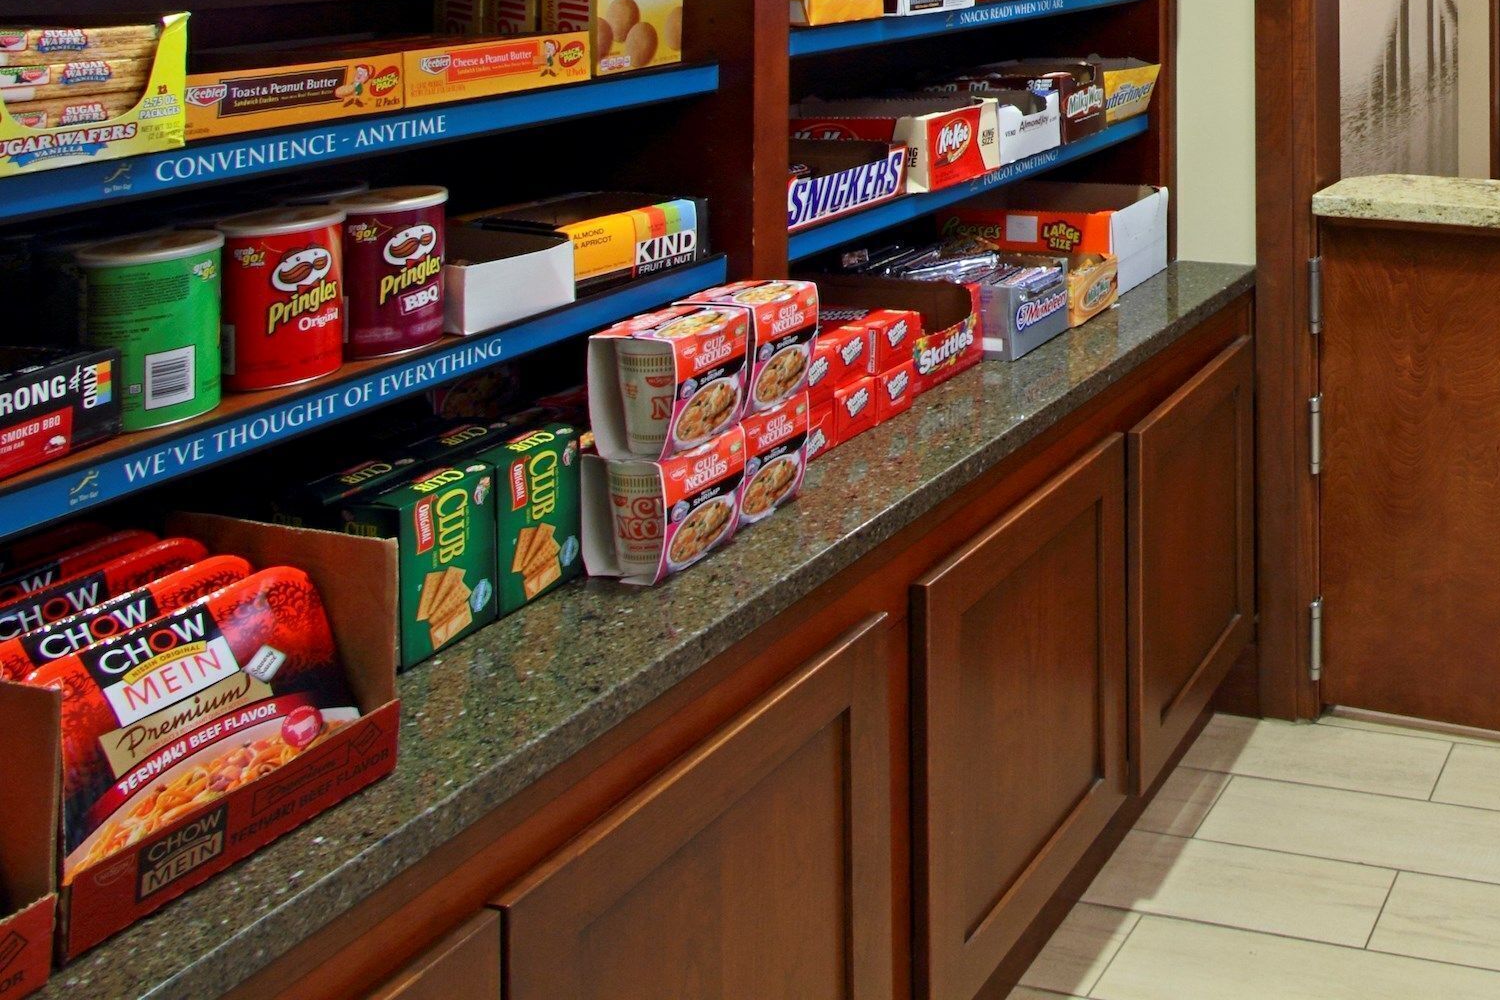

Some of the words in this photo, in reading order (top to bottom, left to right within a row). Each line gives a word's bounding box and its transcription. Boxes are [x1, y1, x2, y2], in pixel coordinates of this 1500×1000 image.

[960, 8, 989, 24] SNACKS
[990, 5, 1013, 19] READY
[1014, 1, 1036, 15] WHEN
[41, 36, 87, 46] WAFERS
[44, 29, 82, 38] SUGAR
[67, 61, 106, 71] SUGAR
[422, 56, 450, 72] Keebler
[452, 56, 478, 68] Cheese
[485, 53, 508, 65] Peanut
[510, 50, 532, 61] Butter
[564, 52, 584, 64] PACK
[65, 69, 110, 78] WAFERS
[372, 75, 396, 87] SNACK
[1026, 79, 1041, 91] 36
[186, 85, 226, 102] Keebler
[231, 85, 261, 99] Toast
[262, 87, 268, 95] &
[270, 80, 304, 94] Peanut
[307, 77, 338, 90] Butter
[375, 79, 399, 93] PACK
[1106, 80, 1154, 110] utterfinger
[65, 104, 102, 116] SUGAR
[139, 106, 181, 119] PACKAGES
[234, 96, 259, 108] Sandwich
[382, 96, 400, 107] Packs
[56, 123, 137, 147] WAFERS
[982, 128, 995, 139] KING
[982, 136, 994, 147] SIZE
[34, 144, 84, 158] VANILLA
[156, 133, 336, 182] CONVENIENCE
[354, 114, 447, 149] ANYTIME
[983, 168, 1014, 187] FORGOT
[1014, 151, 1059, 176] SOMETHING?
[788, 152, 903, 227] SNICKERS
[573, 228, 605, 241] ALMOND
[580, 235, 613, 249] APRICOT
[1044, 223, 1080, 243] LARGE
[635, 230, 696, 265] KIND
[1050, 239, 1071, 251] SIZE
[638, 260, 664, 275] FRUIT
[665, 258, 672, 268] &
[674, 253, 692, 265] NUT
[380, 255, 440, 306] Pringles
[268, 280, 337, 335] Pringles
[404, 285, 439, 312] BBQ
[299, 308, 339, 331] Original
[771, 310, 805, 335] NOODLES
[779, 304, 798, 320] CUP
[703, 336, 725, 351] CUP
[919, 328, 974, 375] Skittles
[694, 343, 732, 370] NOODLES
[700, 369, 725, 386] SHRIMP
[0, 375, 67, 417] RONG
[83, 364, 97, 410] KIND
[124, 438, 206, 484] WE'VE
[213, 394, 335, 450] THOUGHT
[344, 383, 374, 408] OF
[379, 338, 503, 401] EVERYTHING
[767, 414, 787, 431] CUP
[1, 422, 39, 445] SMOKED
[42, 415, 61, 431] BBQ
[442, 426, 488, 446] CLUB
[758, 422, 794, 449] NOODLES
[509, 432, 555, 452] CLUB
[694, 453, 719, 473] CUP
[414, 470, 464, 493] CLUB
[514, 463, 527, 502] ORIGINAL
[530, 450, 557, 521] CLUB
[684, 461, 729, 494] NOODLES
[692, 486, 720, 507] SHRIMP
[419, 502, 433, 545] ORIGINAL
[437, 488, 468, 565] CLUB
[39, 600, 147, 661] CHOW
[98, 613, 206, 674] CHOW
[131, 657, 157, 678] NISSIN
[159, 644, 201, 662] ORIGINAL
[122, 647, 223, 711] MEIN
[116, 673, 251, 758] Premium
[117, 741, 188, 795] TERIYAKI
[190, 723, 222, 749] BEEF
[224, 702, 277, 731] FLAVOR
[230, 802, 296, 845] TERIYAKI
[300, 782, 334, 808] BEEF
[337, 749, 390, 786] FLAVOR
[148, 810, 223, 862] CHOW
[148, 837, 220, 891] MEIN
